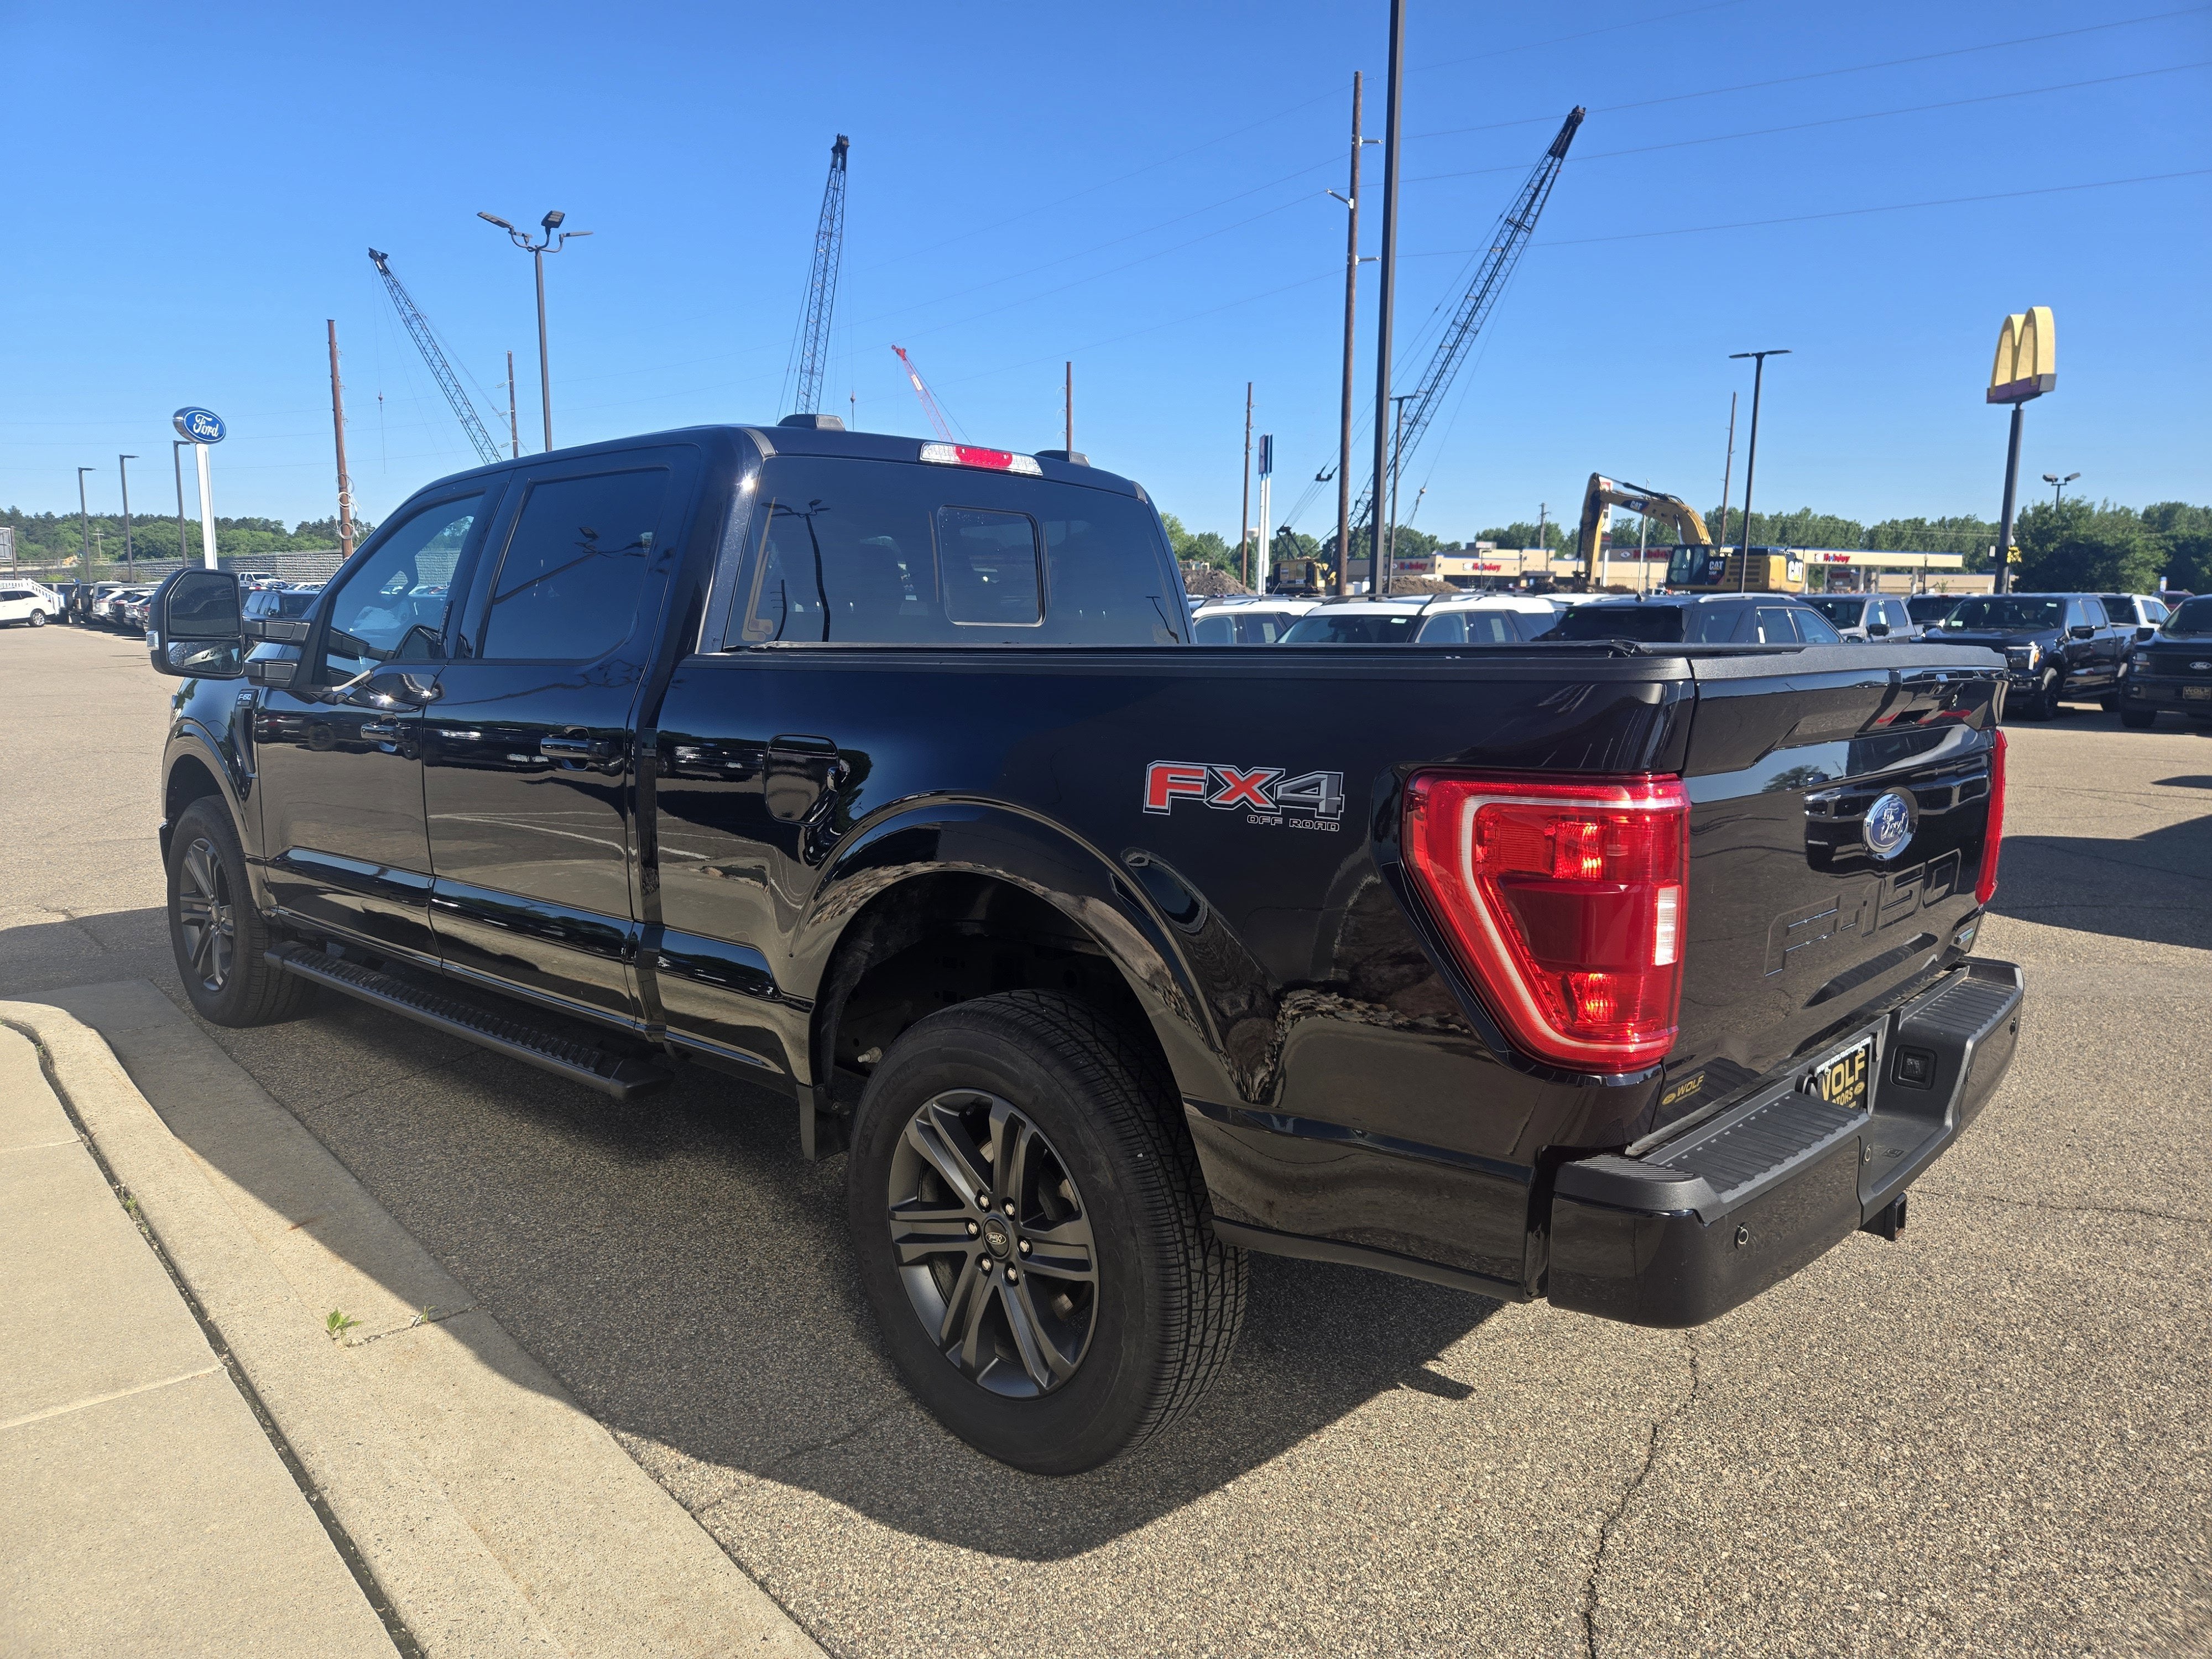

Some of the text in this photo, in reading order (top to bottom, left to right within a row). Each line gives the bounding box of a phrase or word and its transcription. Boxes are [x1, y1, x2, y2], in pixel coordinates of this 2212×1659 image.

[192, 414, 220, 437] Ford
[1630, 500, 1643, 510] CAT
[1709, 561, 1724, 571] CAT
[1787, 561, 1803, 580] CAT
[1143, 760, 1344, 820] FX4
[1247, 815, 1339, 832] OFF ROAD
[1881, 807, 1906, 841] Ford
[1677, 1075, 1704, 1097] WOLF
[988, 1234, 1002, 1243] Ford
